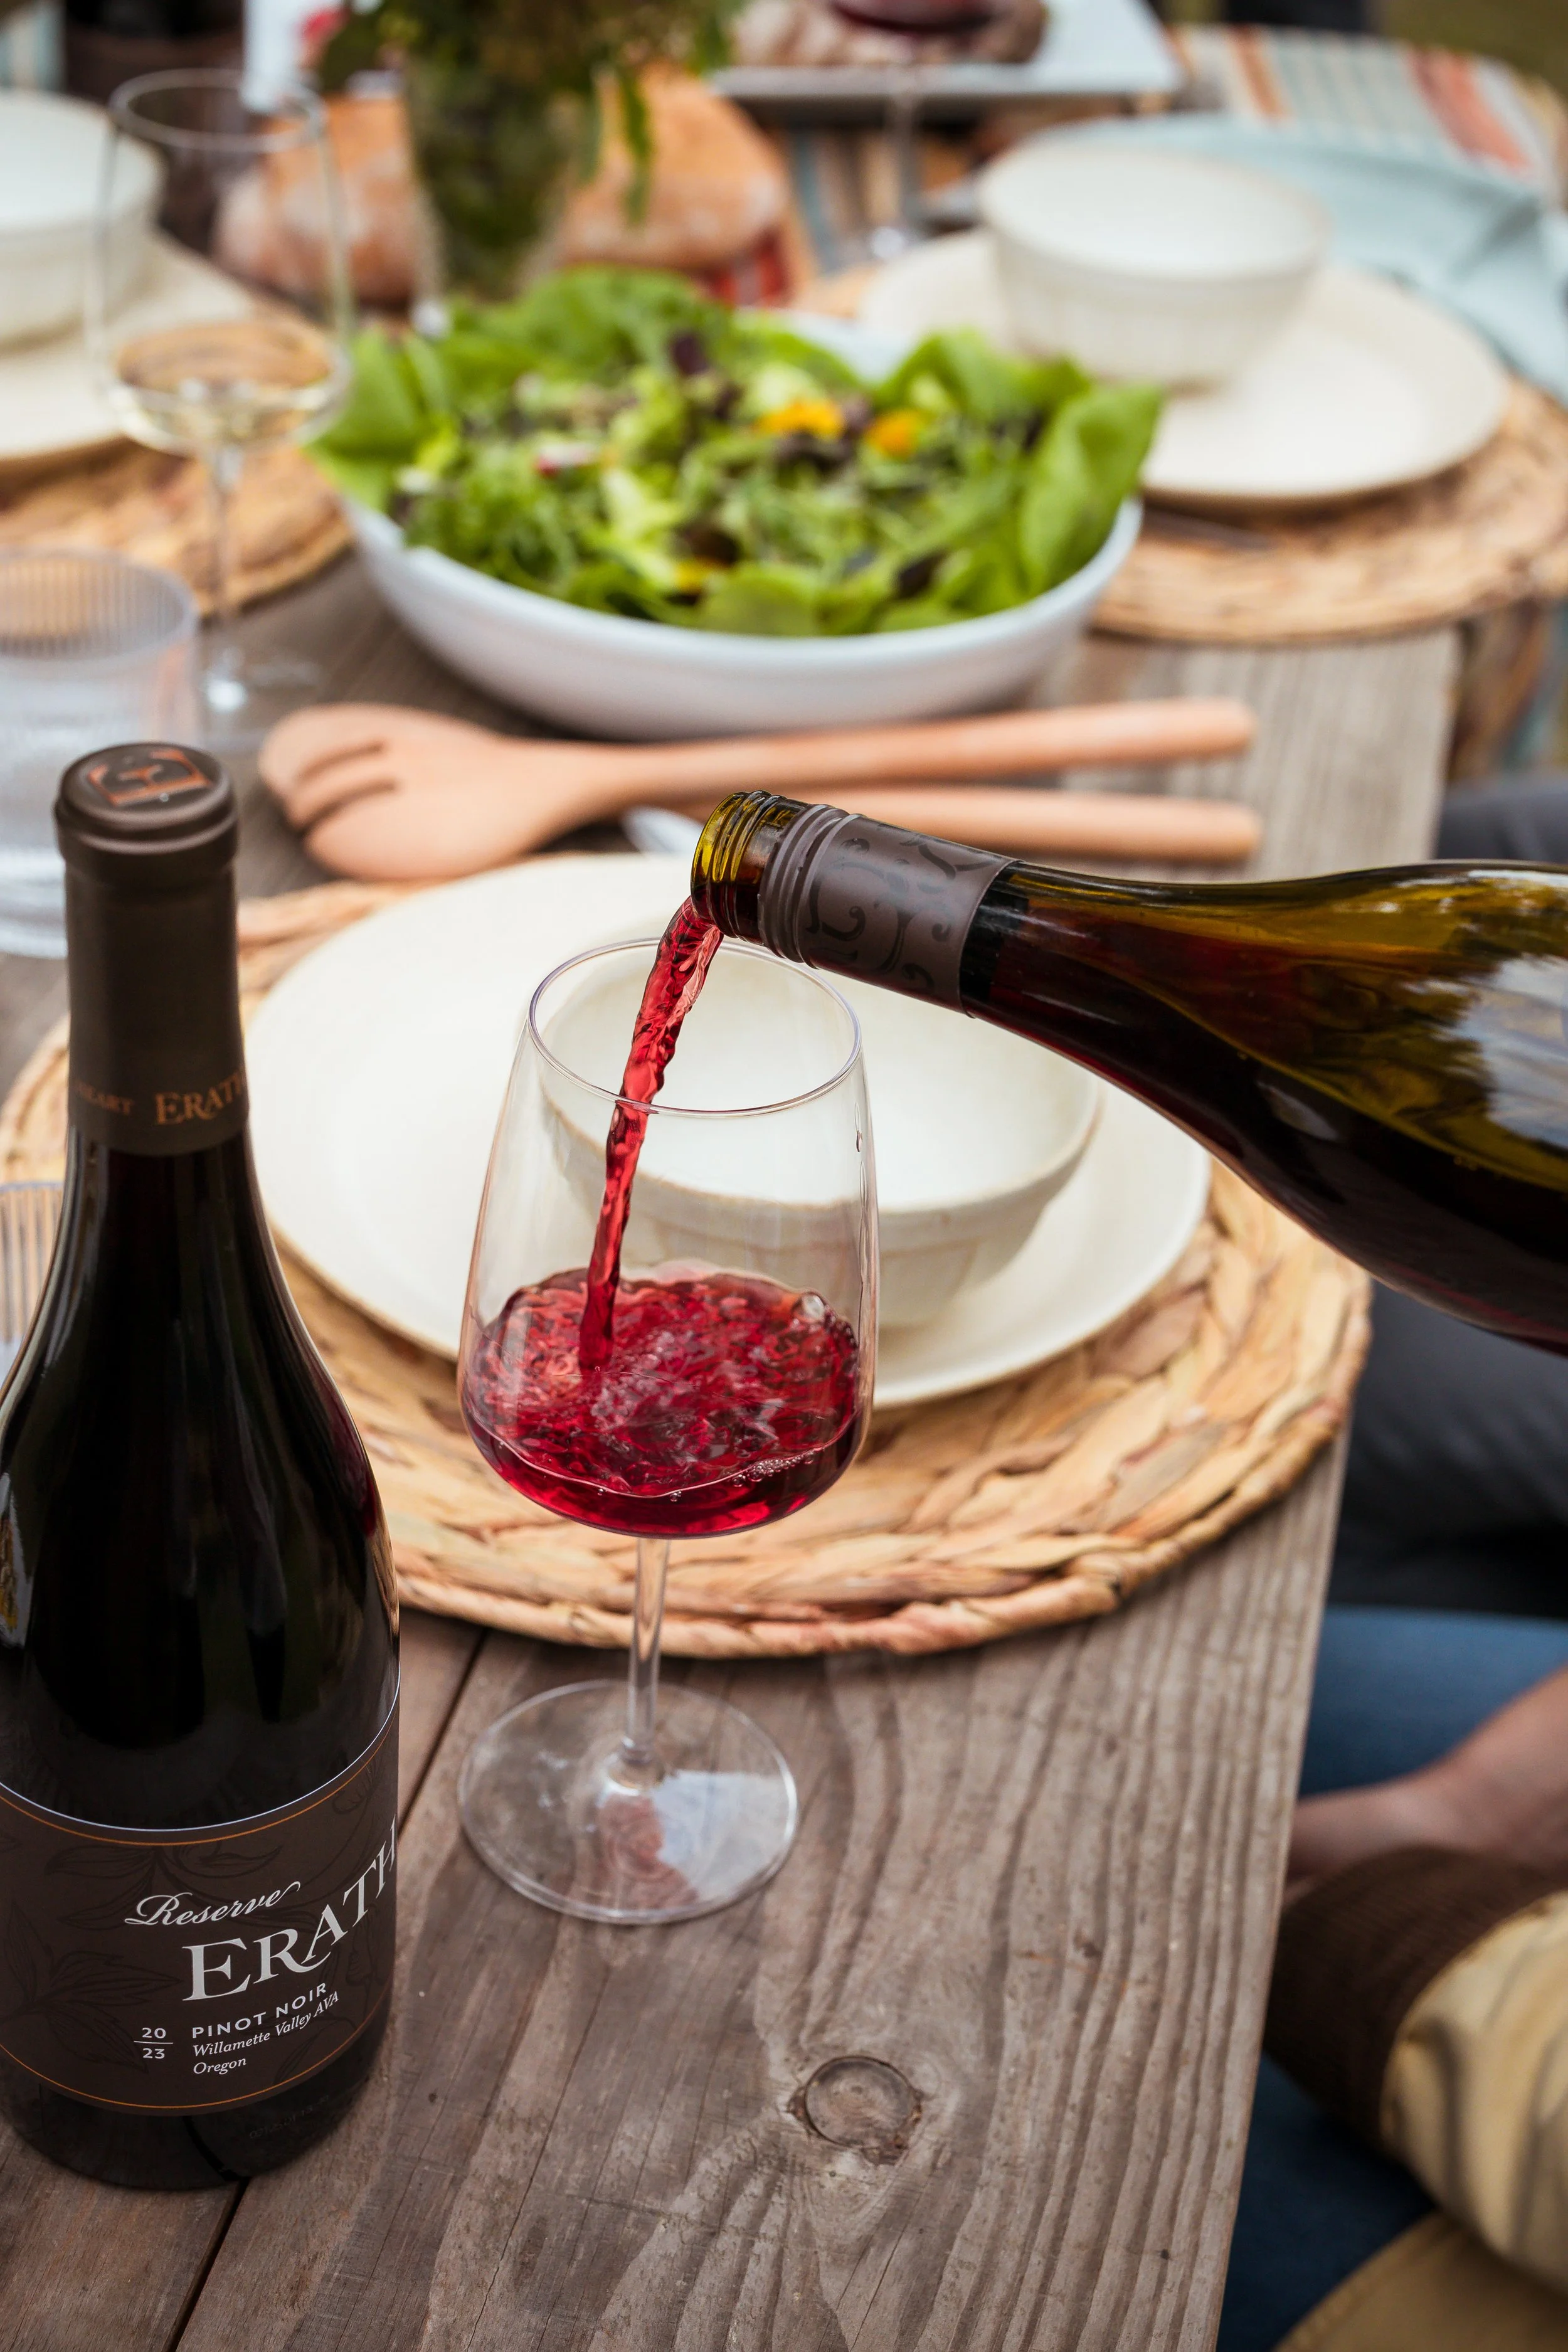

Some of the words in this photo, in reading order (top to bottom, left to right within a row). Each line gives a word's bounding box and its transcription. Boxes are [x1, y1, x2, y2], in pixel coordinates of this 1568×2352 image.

[124, 1880, 301, 1926] Reserve
[182, 1813, 396, 2001] ERATH
[141, 2027, 166, 2039] 20
[192, 2011, 267, 2039] PINOT
[275, 1982, 327, 2018] NOIR
[193, 2032, 270, 2057] Willamette
[275, 2012, 312, 2037] Valley
[313, 1990, 339, 2018] AVA
[142, 2048, 166, 2059] 23
[193, 2057, 246, 2075] Oregon
